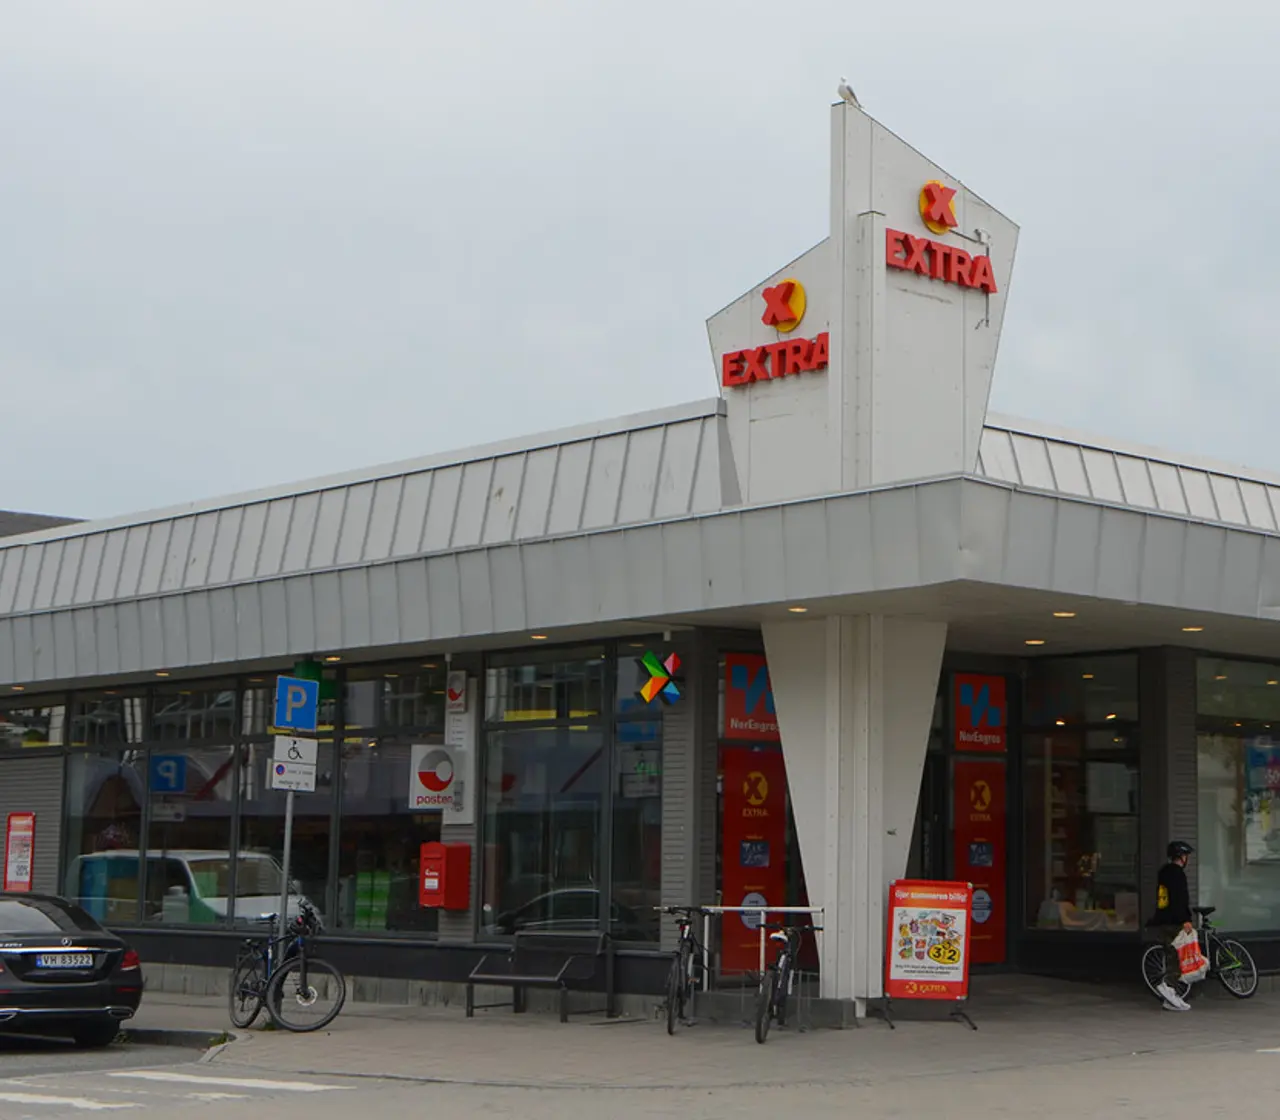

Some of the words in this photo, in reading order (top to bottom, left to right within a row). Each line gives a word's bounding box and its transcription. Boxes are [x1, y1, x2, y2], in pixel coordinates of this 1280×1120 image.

[885, 227, 998, 294] EXTRA
[722, 331, 830, 387] EXTRA
[286, 685, 308, 722] P
[416, 794, 454, 805] posten
[43, 955, 58, 964] VH
